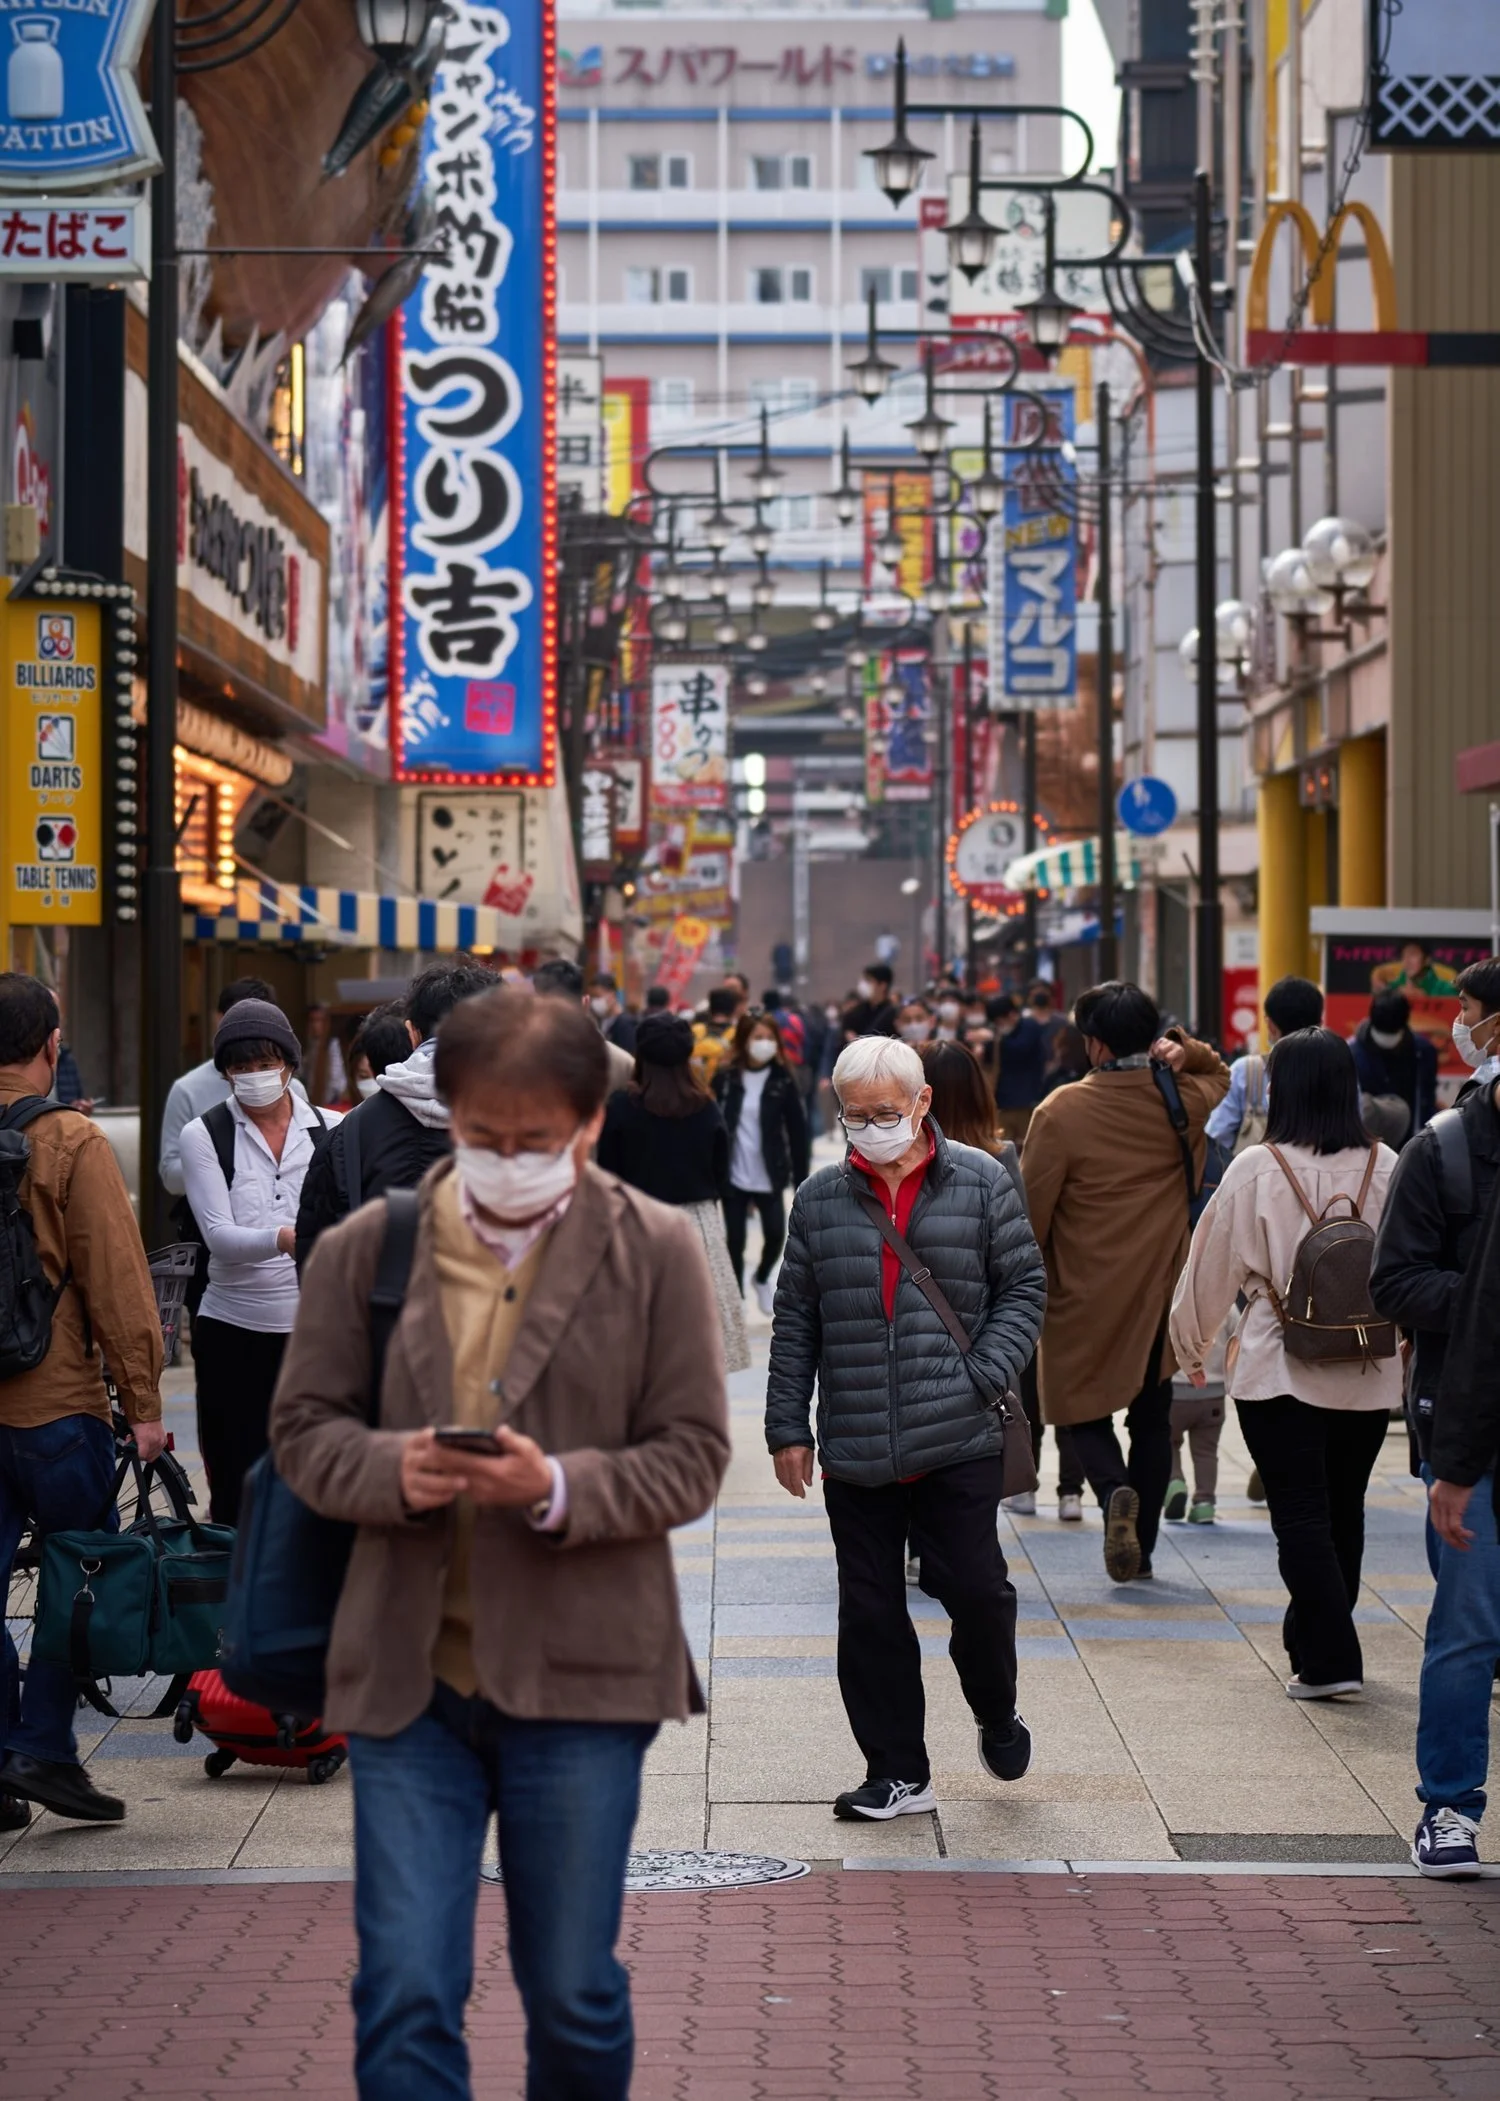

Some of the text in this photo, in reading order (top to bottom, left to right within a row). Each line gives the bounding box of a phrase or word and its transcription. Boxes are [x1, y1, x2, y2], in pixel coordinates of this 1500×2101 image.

[614, 45, 855, 88] スパワールド
[0, 115, 116, 151] ATION
[2, 210, 128, 259] たばこ
[408, 356, 520, 666] つり吉
[1004, 513, 1073, 549] NEW
[1008, 549, 1074, 691] マルコ
[16, 664, 95, 690] BILLIARDS
[31, 766, 82, 789] DARTS
[16, 866, 97, 890] TABLE TENNIS
